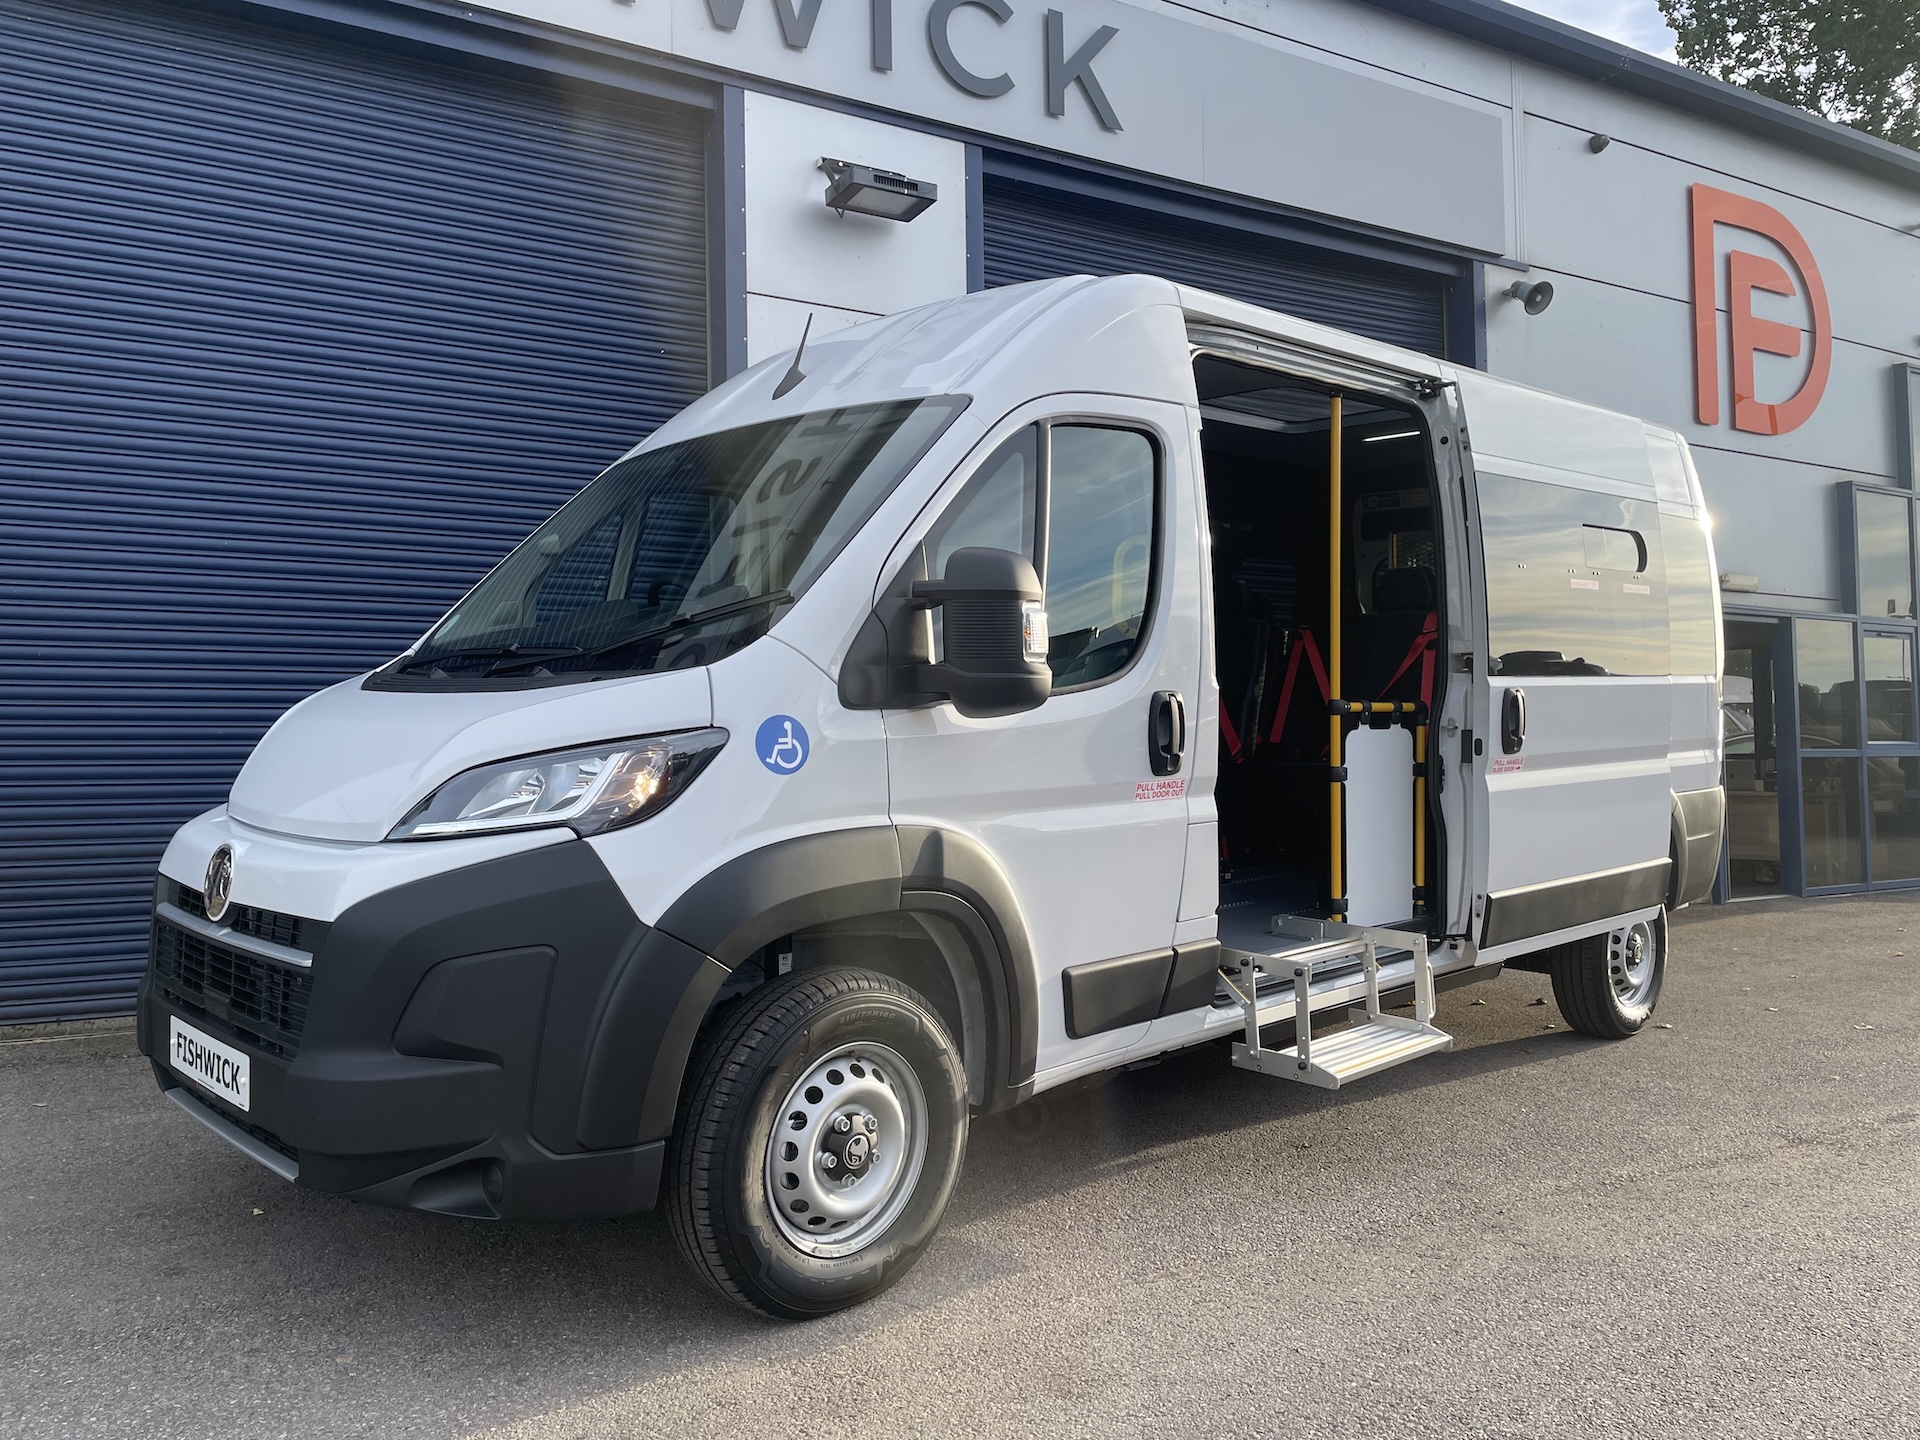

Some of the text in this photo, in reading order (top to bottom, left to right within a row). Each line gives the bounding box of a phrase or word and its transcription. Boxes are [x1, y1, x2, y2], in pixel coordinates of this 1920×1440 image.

[1136, 780, 1185, 791] PULL HANDLE
[1152, 790, 1171, 798] DOOR
[1171, 789, 1183, 797] OUT
[176, 1031, 241, 1095] FISHWICK
